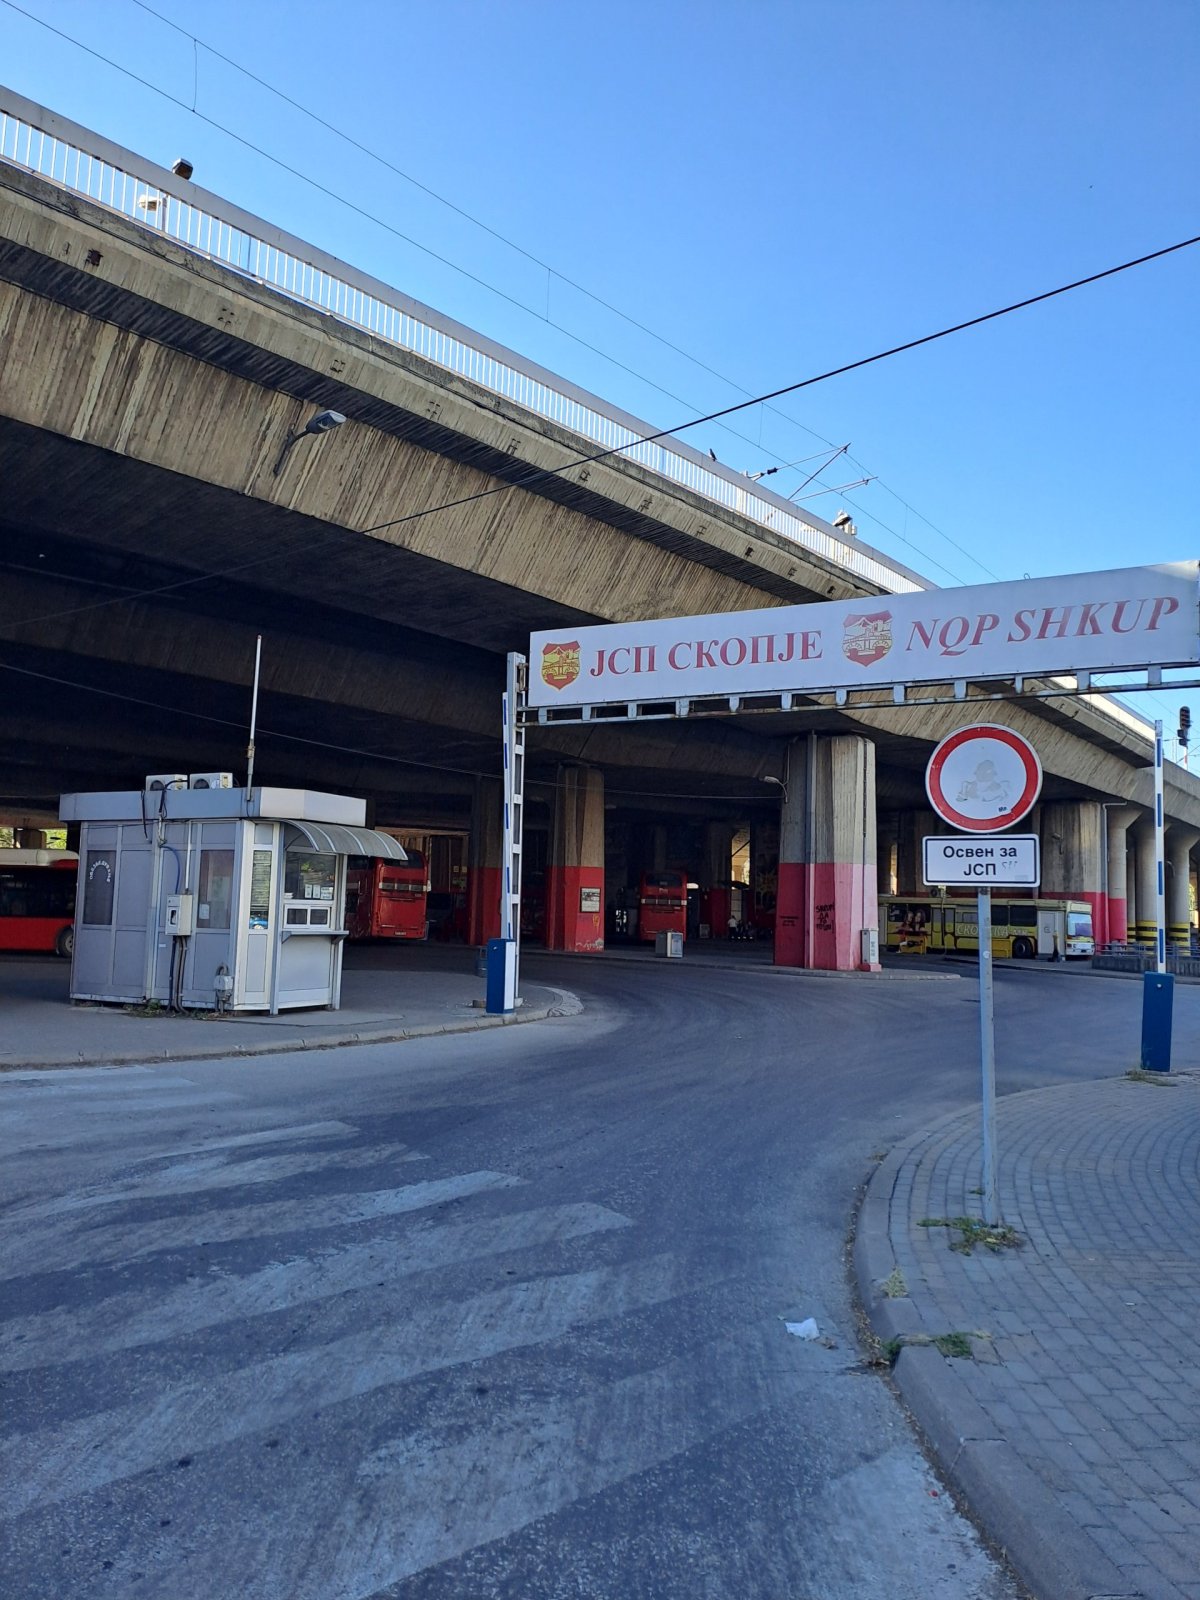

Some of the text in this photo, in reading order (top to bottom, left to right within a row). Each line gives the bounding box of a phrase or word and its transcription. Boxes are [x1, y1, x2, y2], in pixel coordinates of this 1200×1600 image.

[905, 596, 1179, 656] NQP SHKUP
[589, 629, 823, 677] ЈСП СКОПЈЕ
[943, 845, 1017, 859] Освен за
[963, 863, 997, 877] ЈСП
